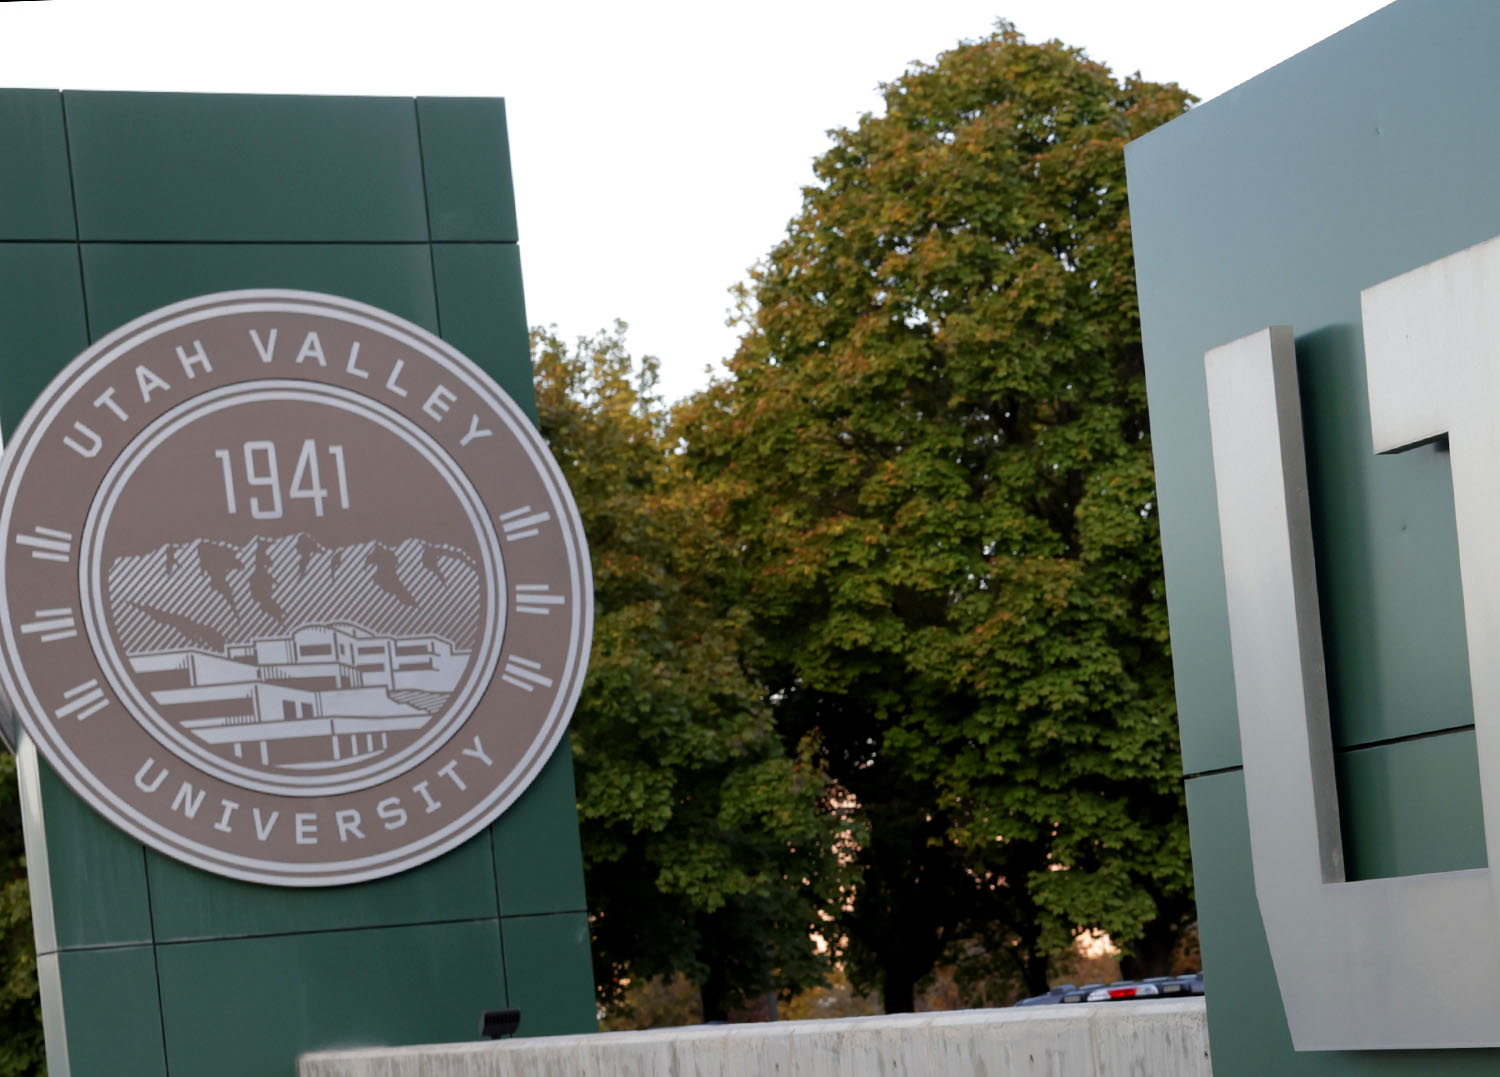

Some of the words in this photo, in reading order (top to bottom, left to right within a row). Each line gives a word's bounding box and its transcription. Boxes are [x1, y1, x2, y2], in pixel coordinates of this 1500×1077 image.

[63, 340, 213, 459] UTAH
[249, 328, 493, 447] VALLEY
[215, 439, 350, 520] 1941
[134, 735, 495, 845] UNIVERSITY
